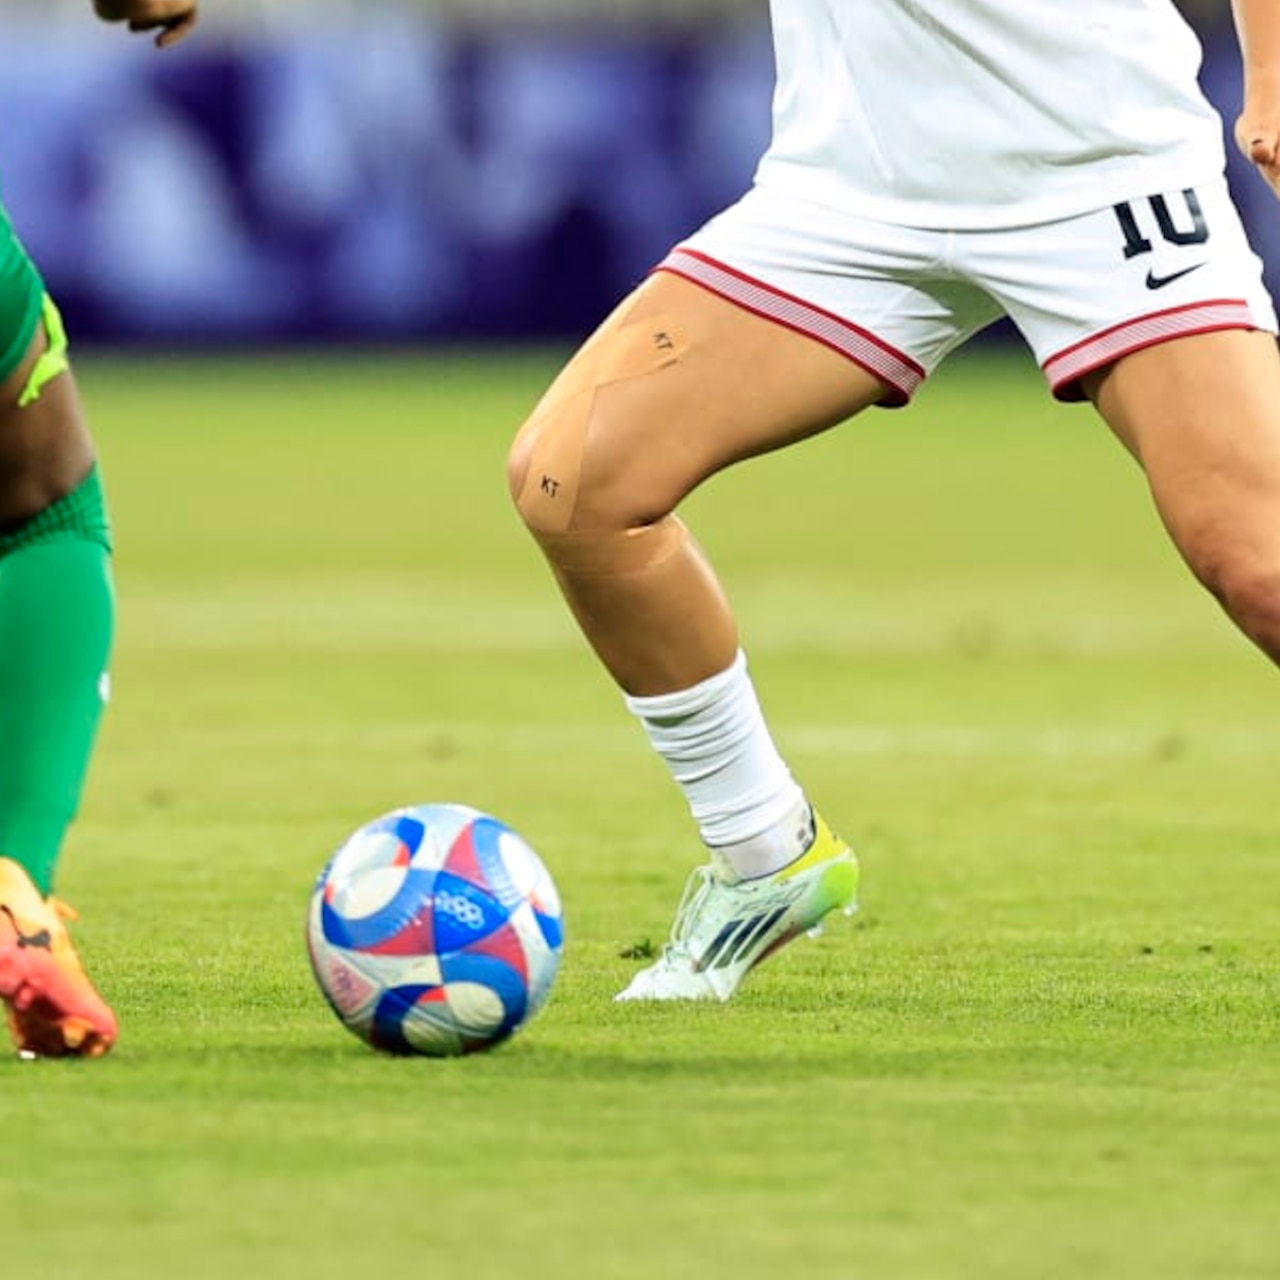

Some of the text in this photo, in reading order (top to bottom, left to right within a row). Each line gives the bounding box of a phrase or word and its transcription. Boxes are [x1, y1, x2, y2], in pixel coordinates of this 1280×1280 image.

[1113, 187, 1210, 259] 10
[654, 331, 674, 351] KT
[540, 475, 560, 498] KT
